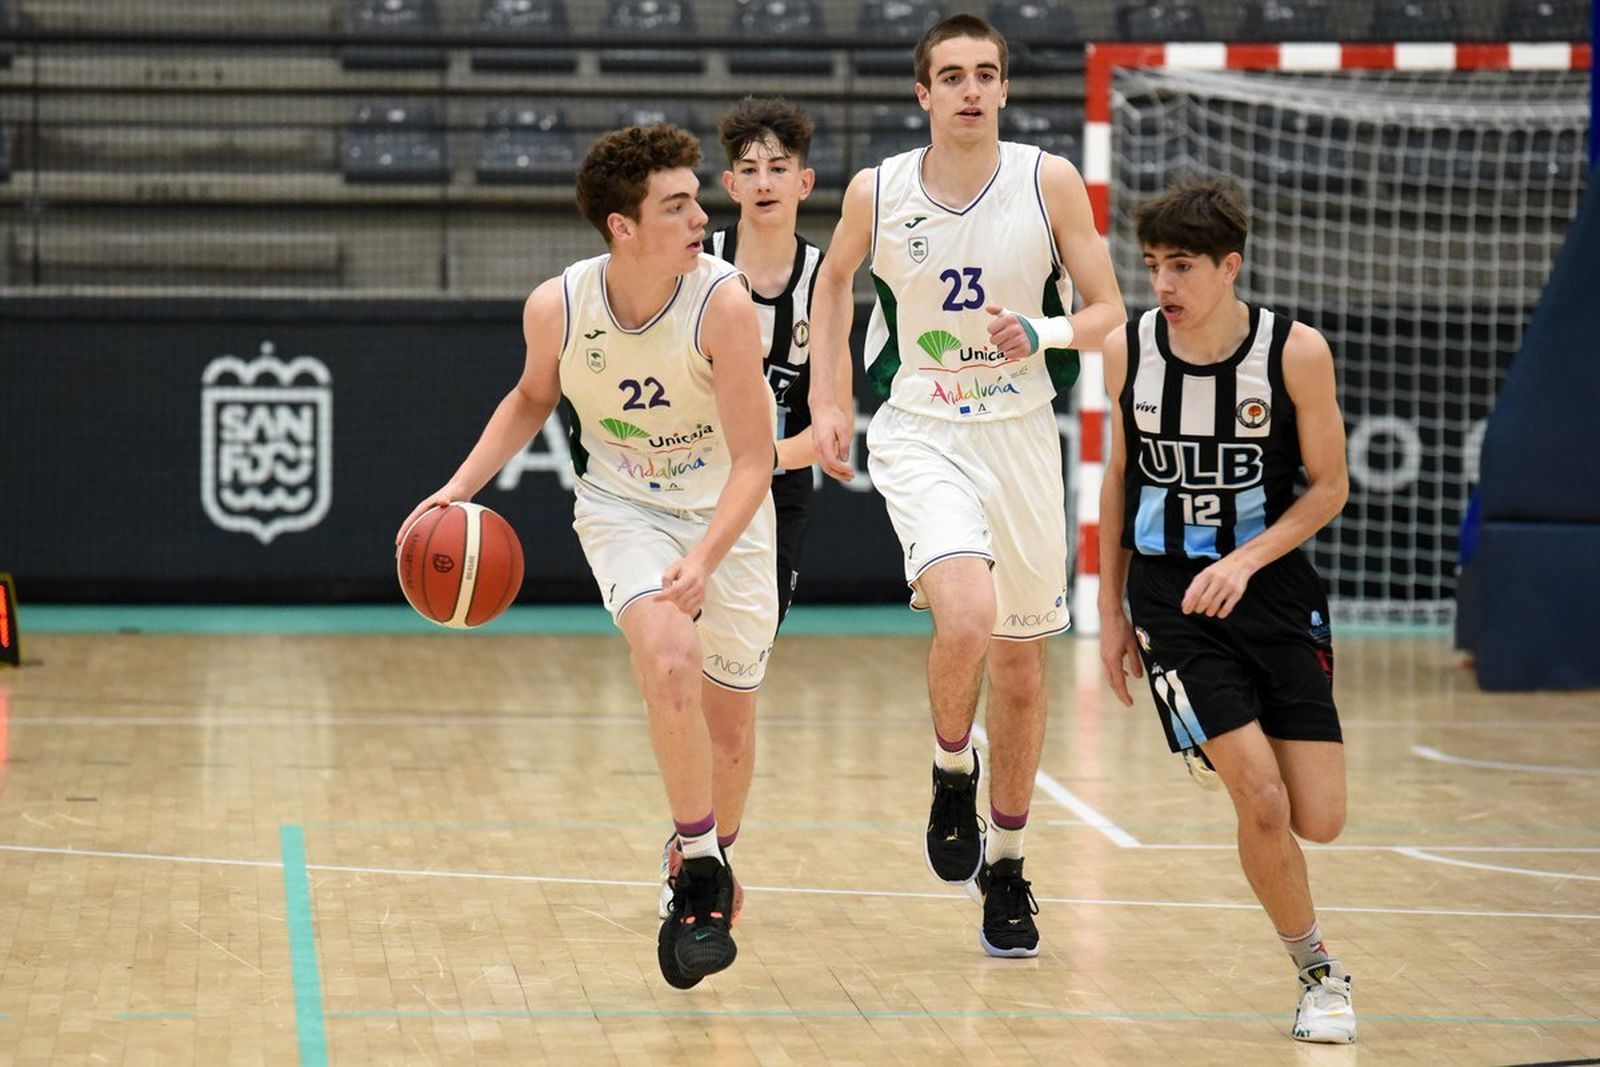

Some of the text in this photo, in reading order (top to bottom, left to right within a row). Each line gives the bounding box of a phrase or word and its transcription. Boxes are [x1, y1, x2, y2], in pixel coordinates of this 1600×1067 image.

[939, 267, 985, 312] 23
[959, 346, 1010, 362] Unica
[618, 376, 671, 411] 22
[219, 404, 315, 443] SAN
[649, 423, 714, 448] Unicaja
[1138, 436, 1264, 490] ULB
[1177, 493, 1222, 527] 12
